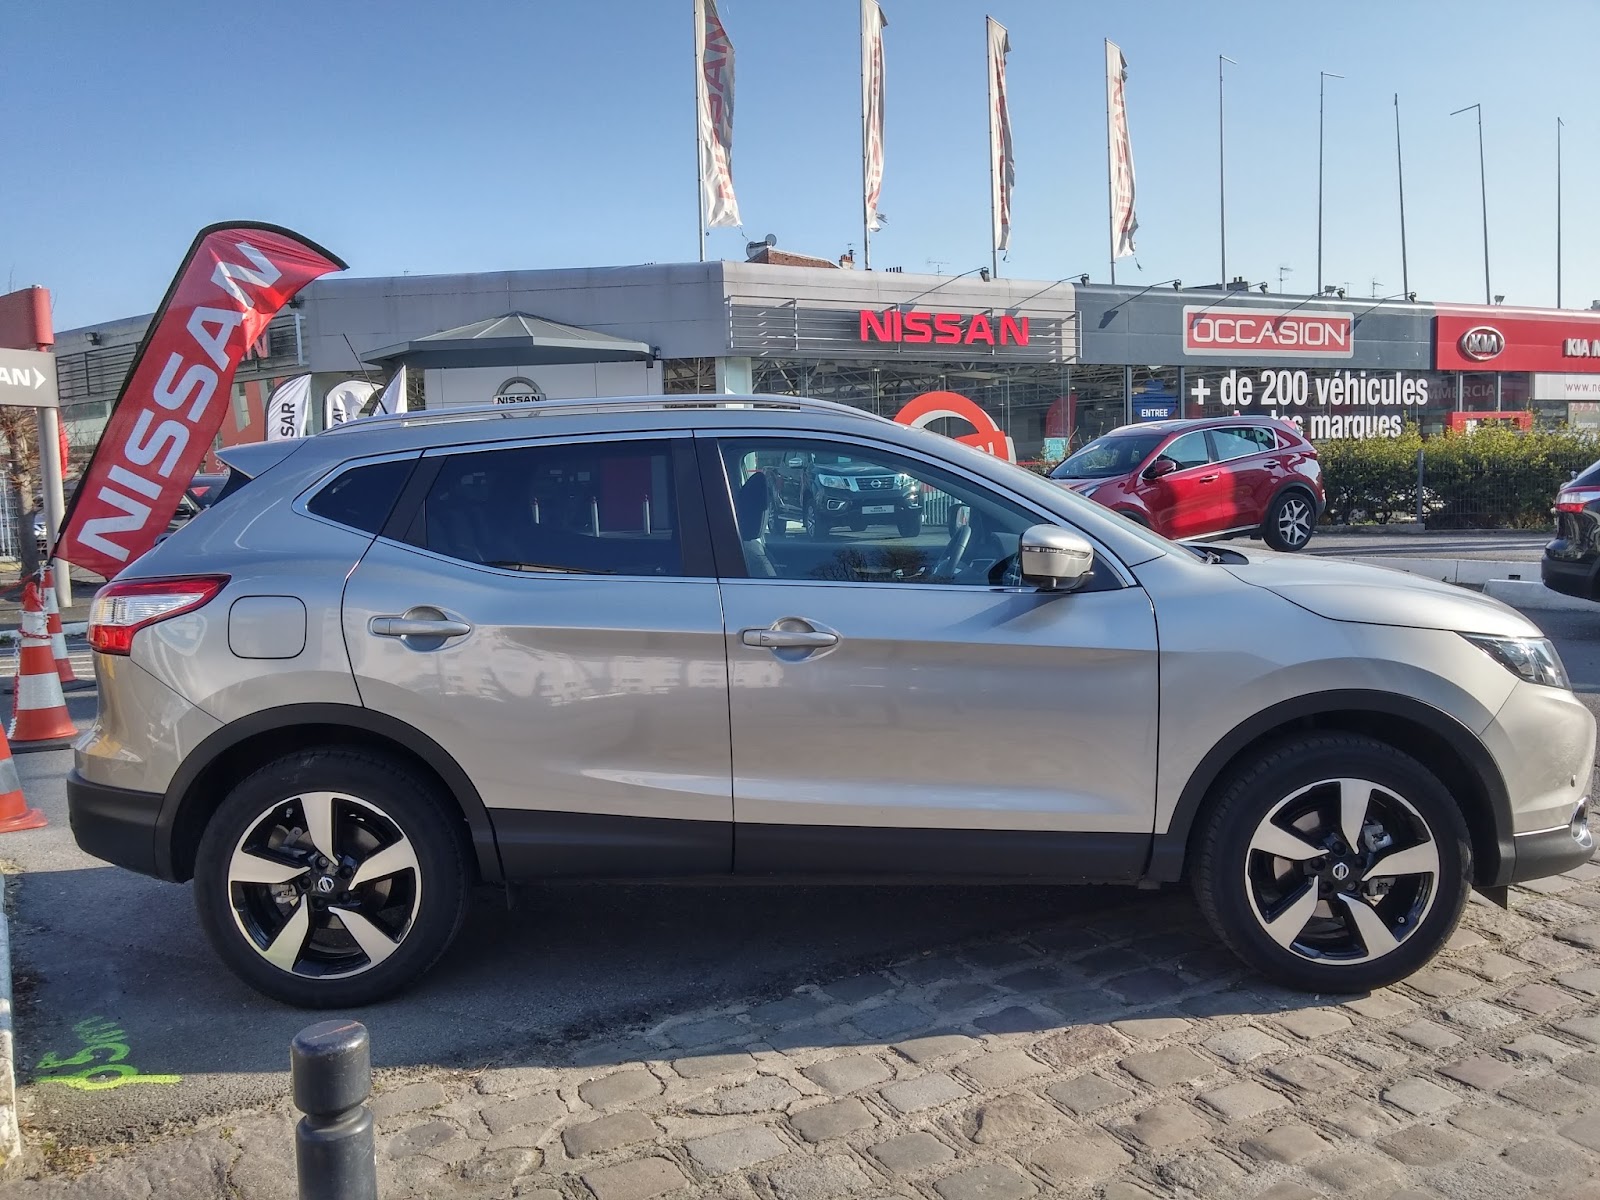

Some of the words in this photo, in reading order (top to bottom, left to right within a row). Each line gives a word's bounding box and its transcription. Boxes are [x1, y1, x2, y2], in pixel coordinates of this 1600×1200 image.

[859, 310, 1029, 347] NISSAN
[1193, 318, 1345, 347] OCCASION
[1469, 334, 1498, 353] KIA
[1565, 338, 1590, 356] KIA
[497, 395, 540, 404] NISSAN
[1220, 369, 1253, 405] de
[1261, 370, 1309, 405] 200
[1315, 369, 1429, 405] véhicules
[76, 241, 283, 563] NISSAN
[1141, 408, 1168, 417] ENTREE
[1310, 414, 1402, 442] marques
